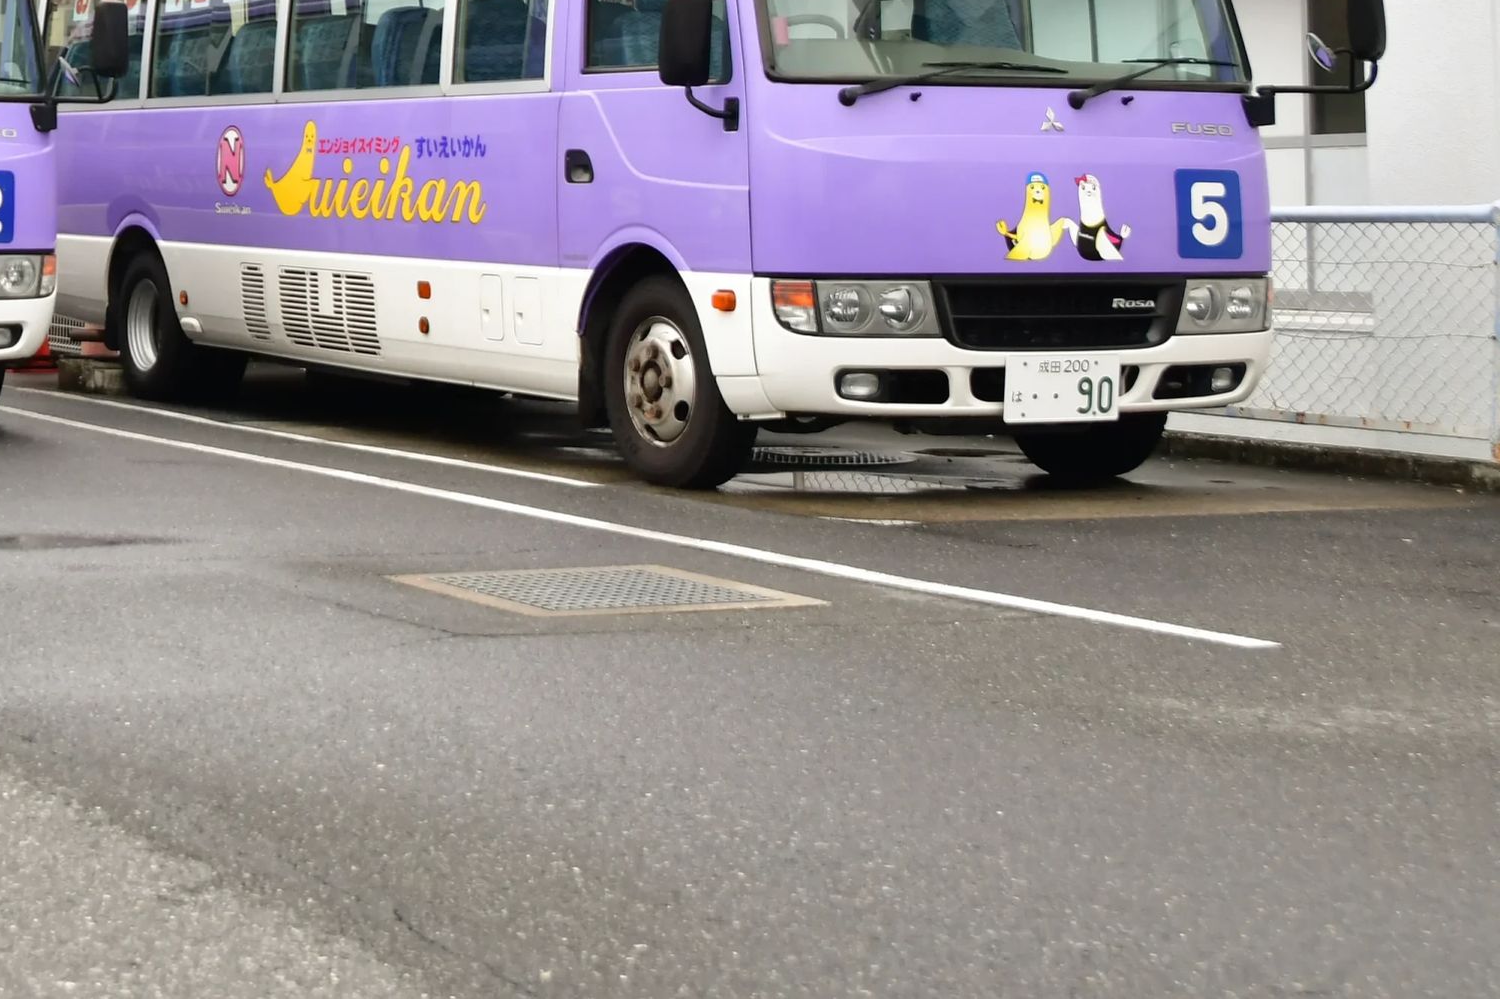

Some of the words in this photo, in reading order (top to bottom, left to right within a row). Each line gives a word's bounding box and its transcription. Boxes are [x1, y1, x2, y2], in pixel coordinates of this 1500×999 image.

[1171, 123, 1234, 136] FUSO
[318, 136, 400, 154] エンジョイスイミング
[415, 135, 487, 159] すいえいかん
[1190, 181, 1229, 246] 5
[1076, 376, 1113, 414] 90
